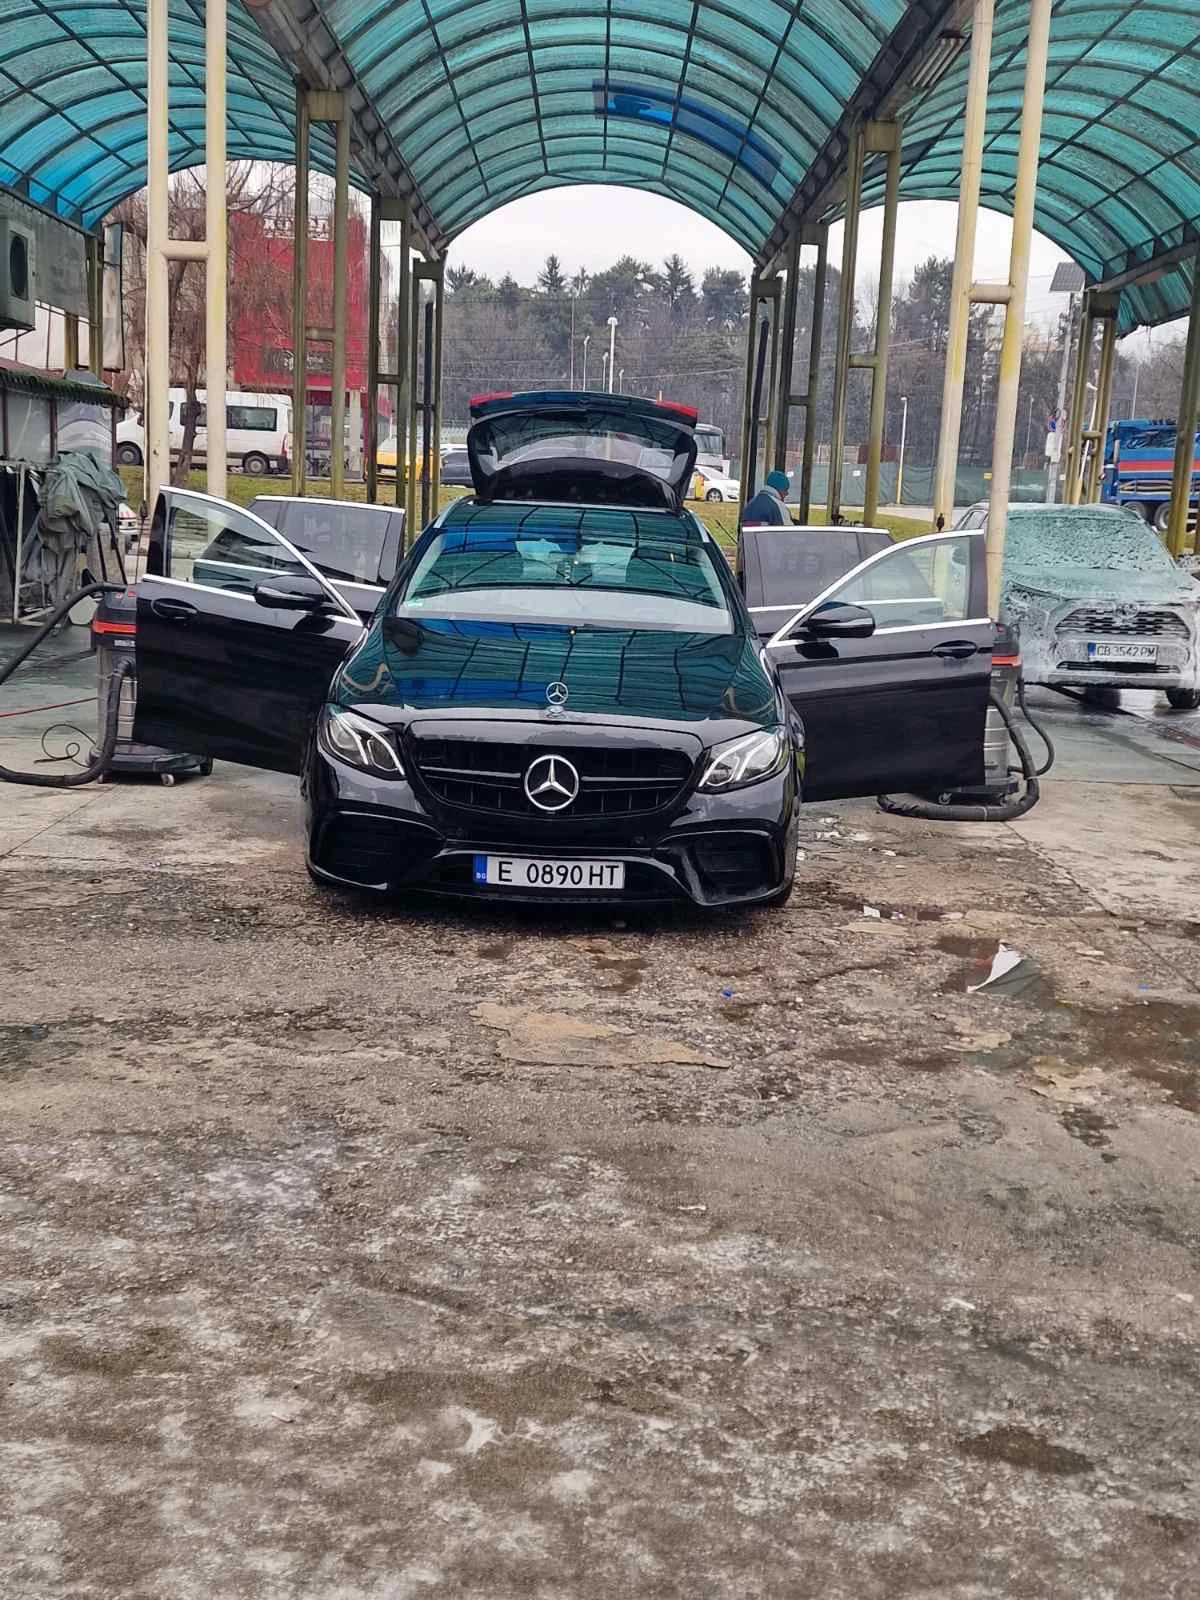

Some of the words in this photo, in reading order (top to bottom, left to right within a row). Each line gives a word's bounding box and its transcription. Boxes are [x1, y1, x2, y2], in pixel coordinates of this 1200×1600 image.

[1097, 645, 1110, 657] CB
[498, 861, 513, 882] E
[526, 863, 583, 886] 0890
[589, 865, 619, 886] HT
